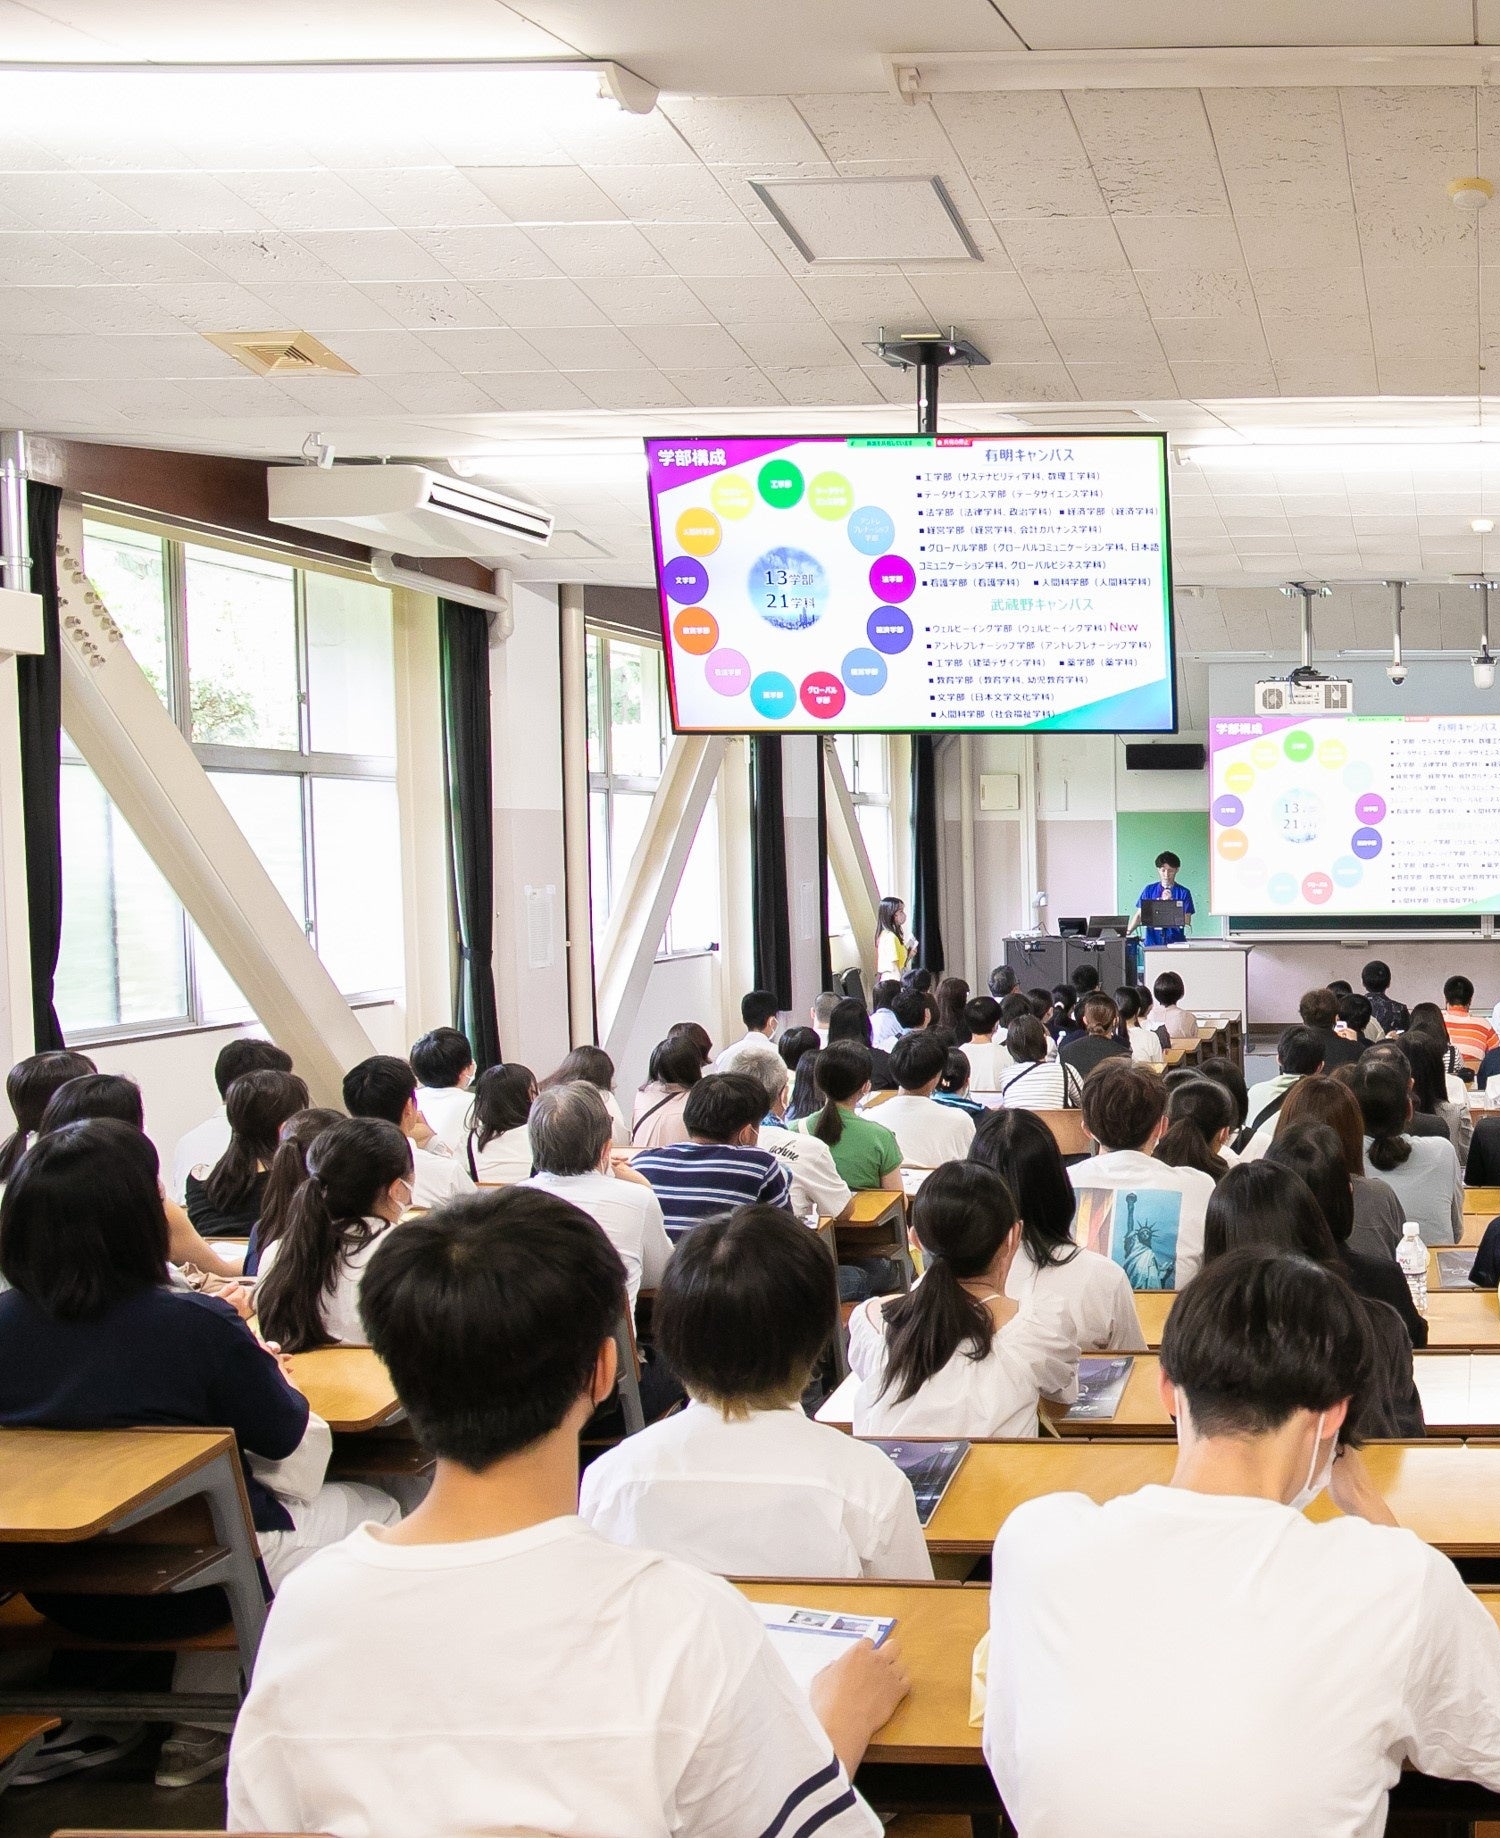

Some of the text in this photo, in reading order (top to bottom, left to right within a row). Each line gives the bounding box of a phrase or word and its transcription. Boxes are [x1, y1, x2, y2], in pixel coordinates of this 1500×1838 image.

[658, 448, 727, 467] 学部構成
[985, 449, 1075, 462] 有明キャンパス
[991, 598, 1094, 612] 武蔵野キャンパス
[1109, 622, 1139, 632] New
[938, 692, 1055, 702] 文学部（日本文学文化学科）
